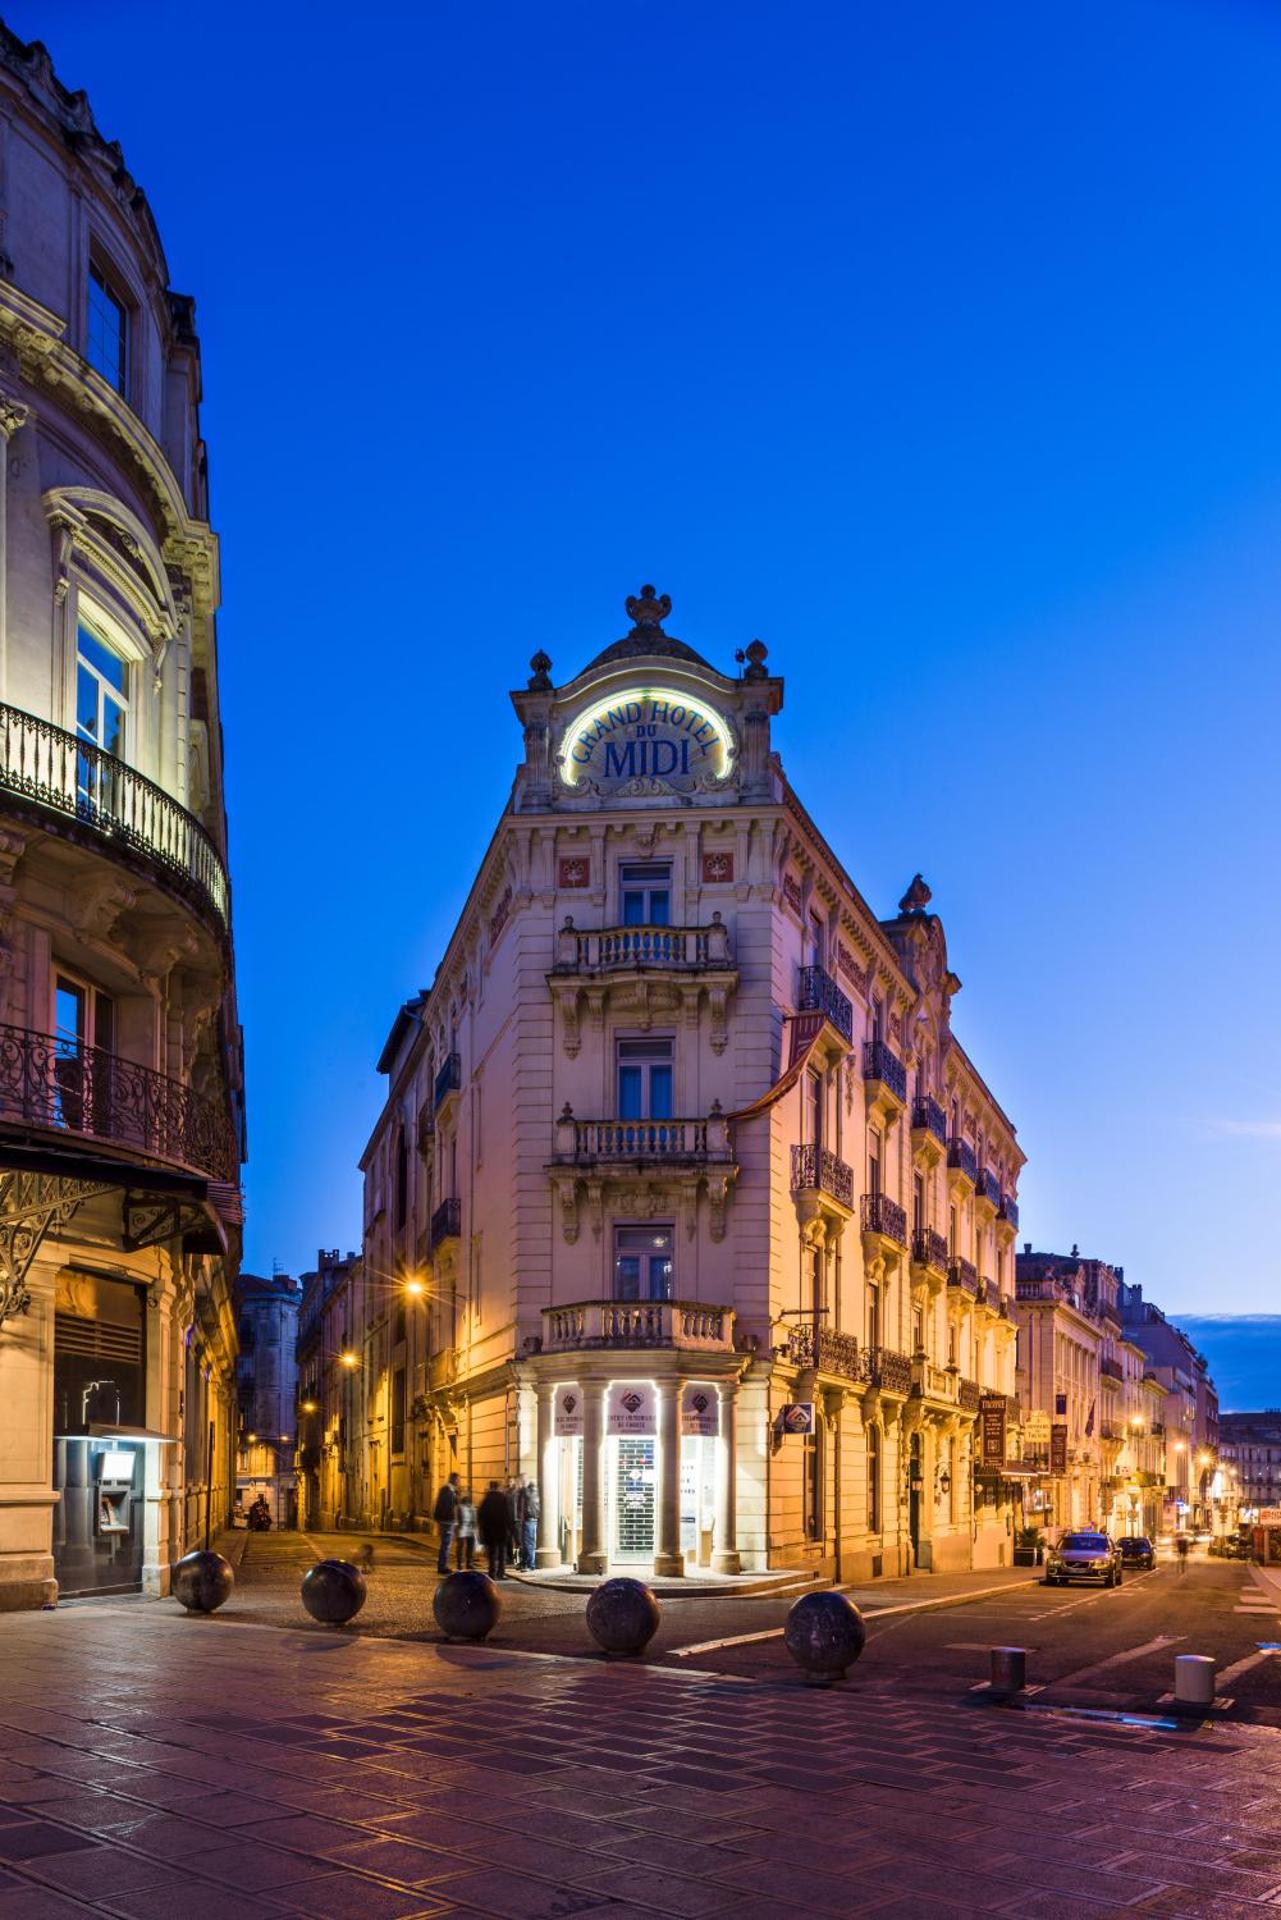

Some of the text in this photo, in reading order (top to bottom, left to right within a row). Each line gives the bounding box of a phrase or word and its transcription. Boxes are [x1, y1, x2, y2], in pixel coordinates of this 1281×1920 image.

[572, 701, 720, 764] GRAND HOTEL
[636, 725, 657, 738] DU
[604, 739, 690, 778] MIDI
